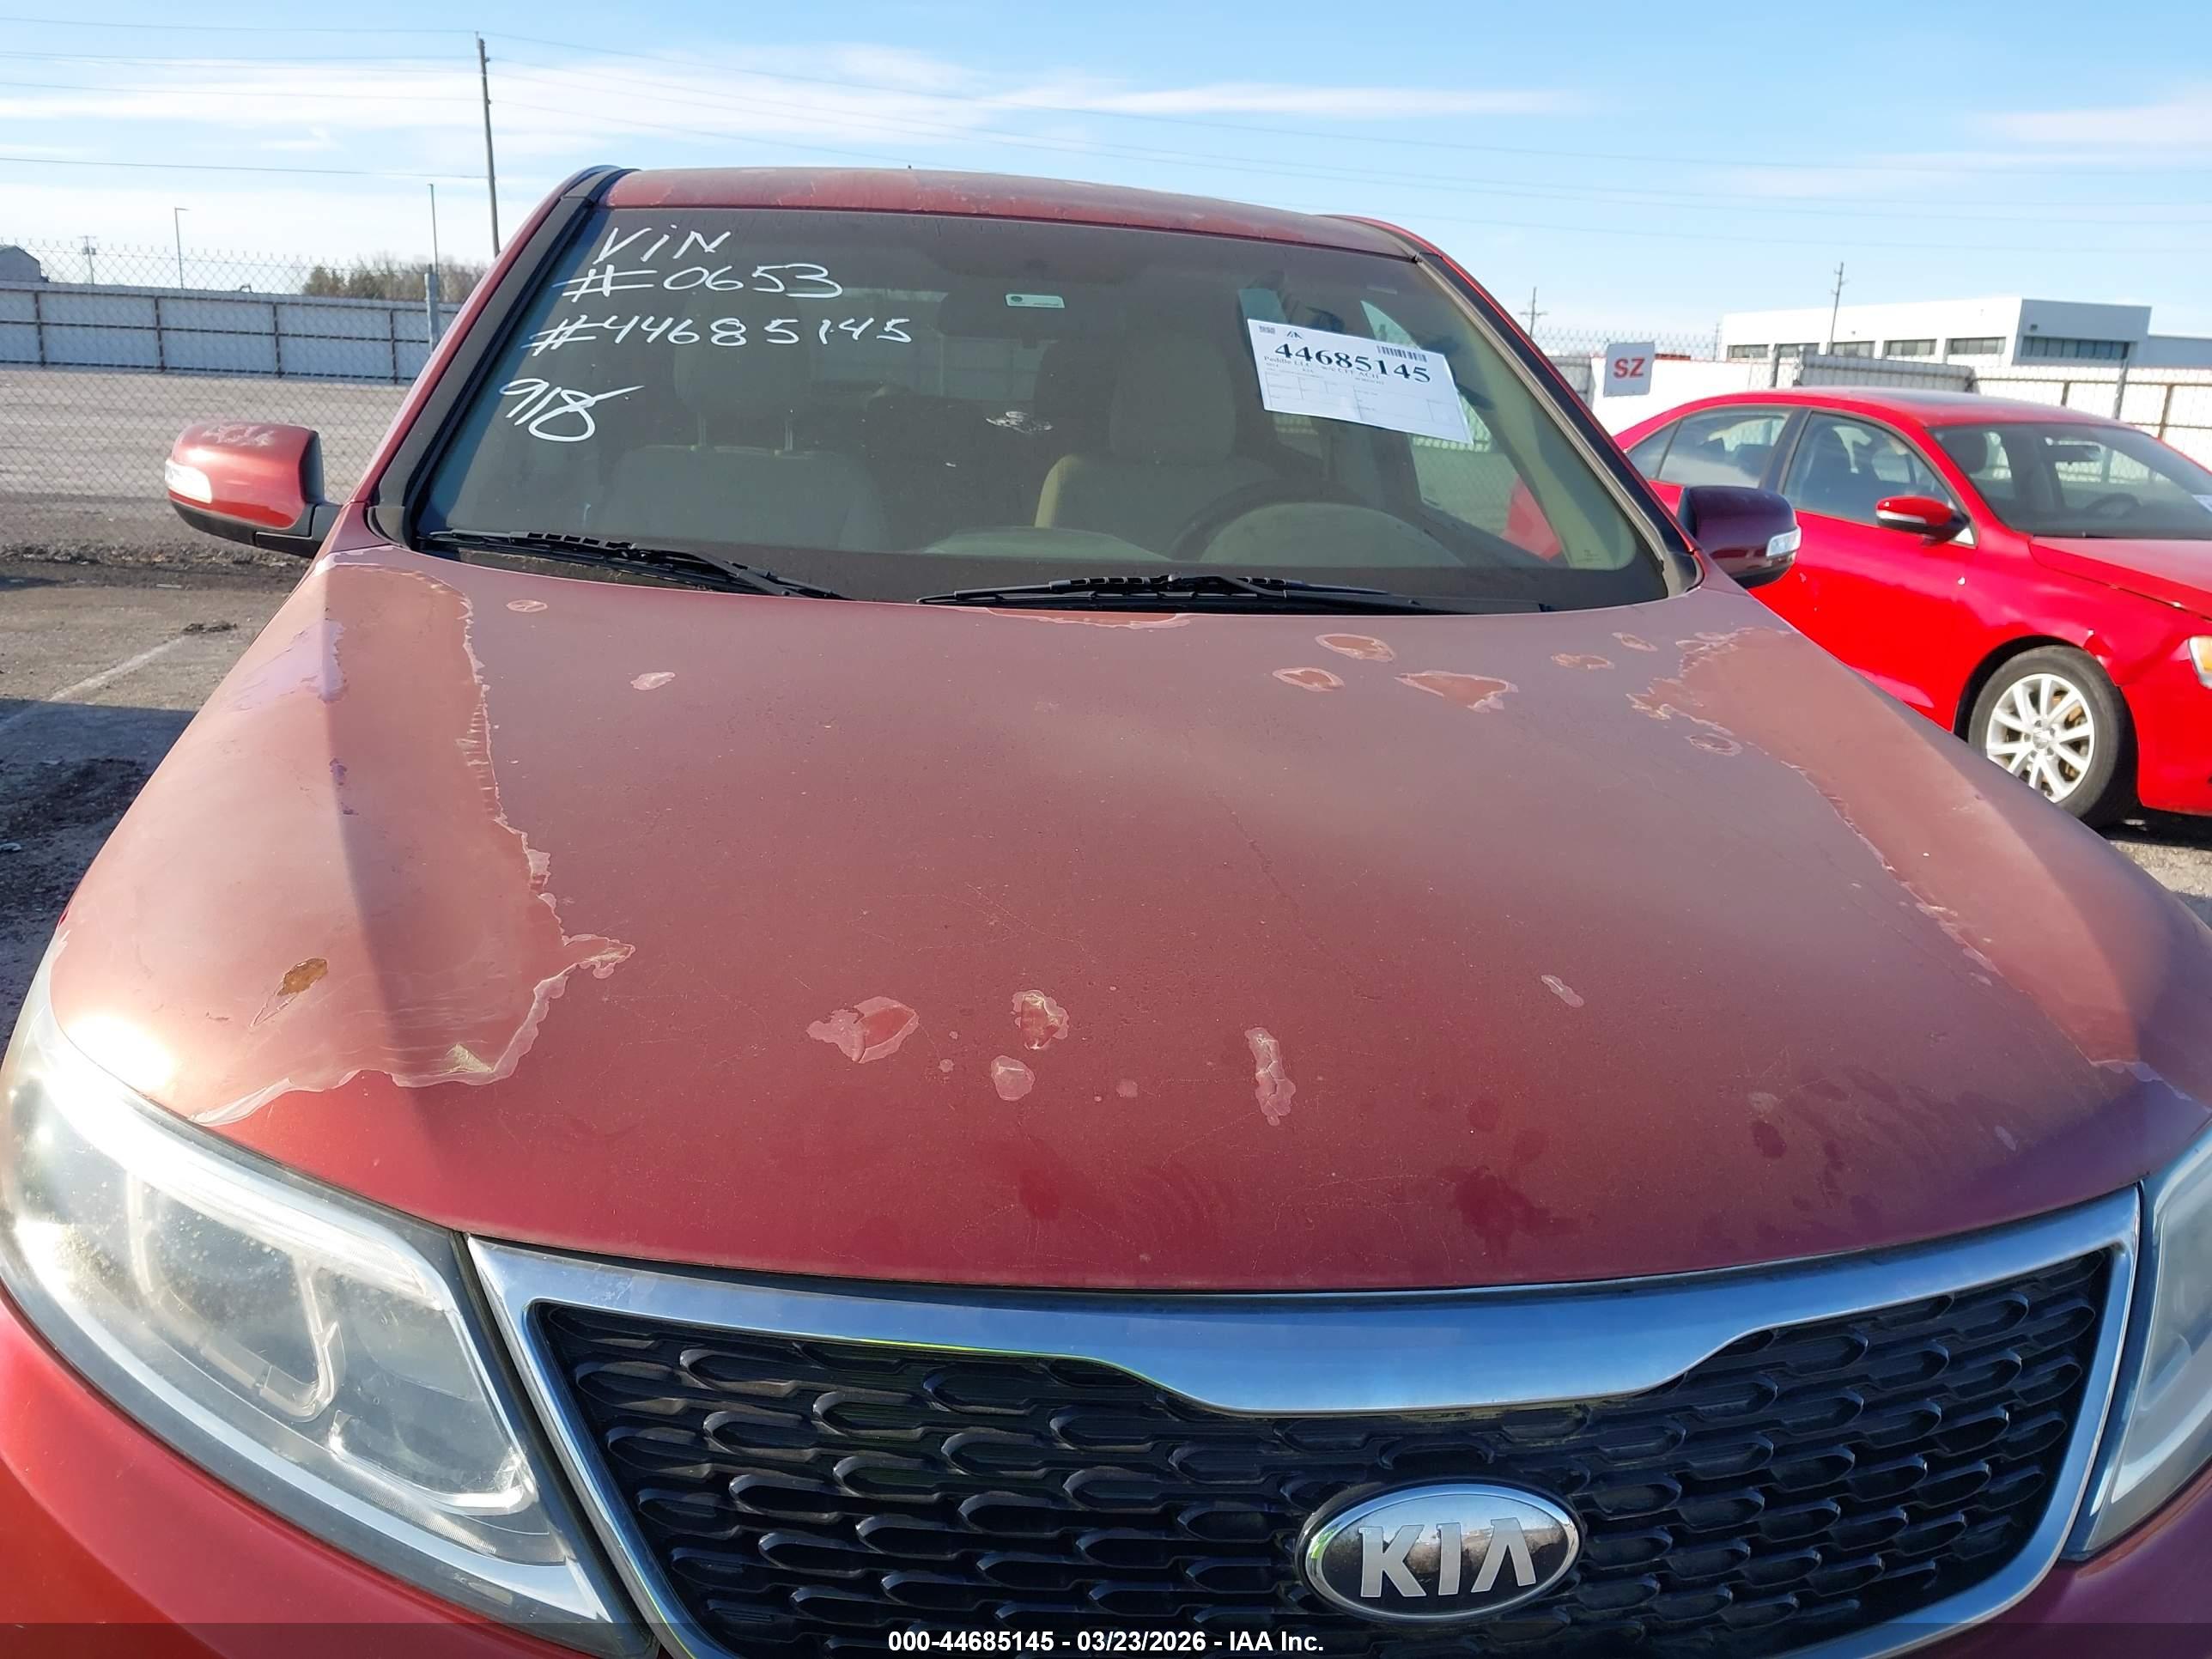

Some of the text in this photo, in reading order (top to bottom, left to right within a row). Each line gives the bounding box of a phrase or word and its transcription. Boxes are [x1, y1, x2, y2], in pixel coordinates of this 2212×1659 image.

[552, 263, 843, 302] #0653
[520, 314, 912, 356] #44685145
[1274, 343, 1431, 383] 44685145
[1613, 357, 1645, 379] SZ
[1358, 1516, 1537, 1598] KIA
